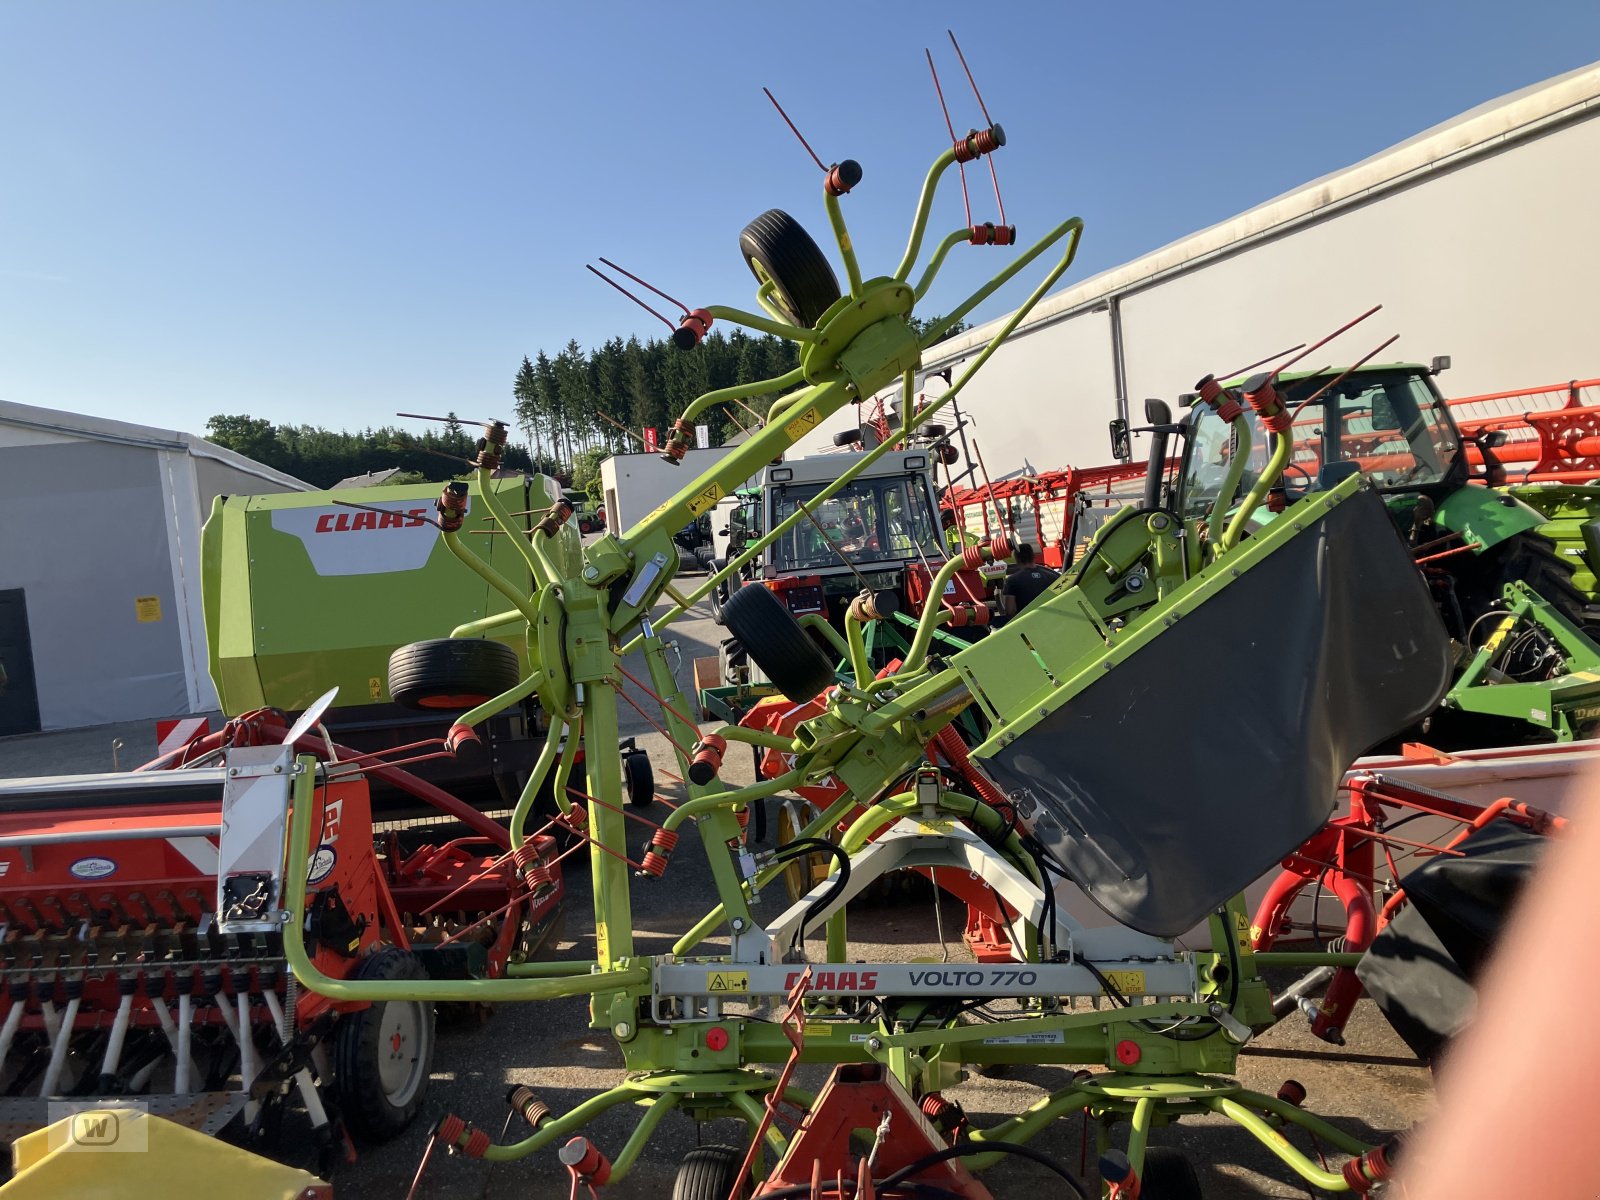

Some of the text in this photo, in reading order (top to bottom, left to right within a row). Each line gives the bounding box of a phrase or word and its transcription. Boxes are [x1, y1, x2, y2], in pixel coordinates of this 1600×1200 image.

[315, 508, 428, 534] CLAAS
[908, 970, 985, 987] VOLTO
[989, 970, 1038, 987] 770
